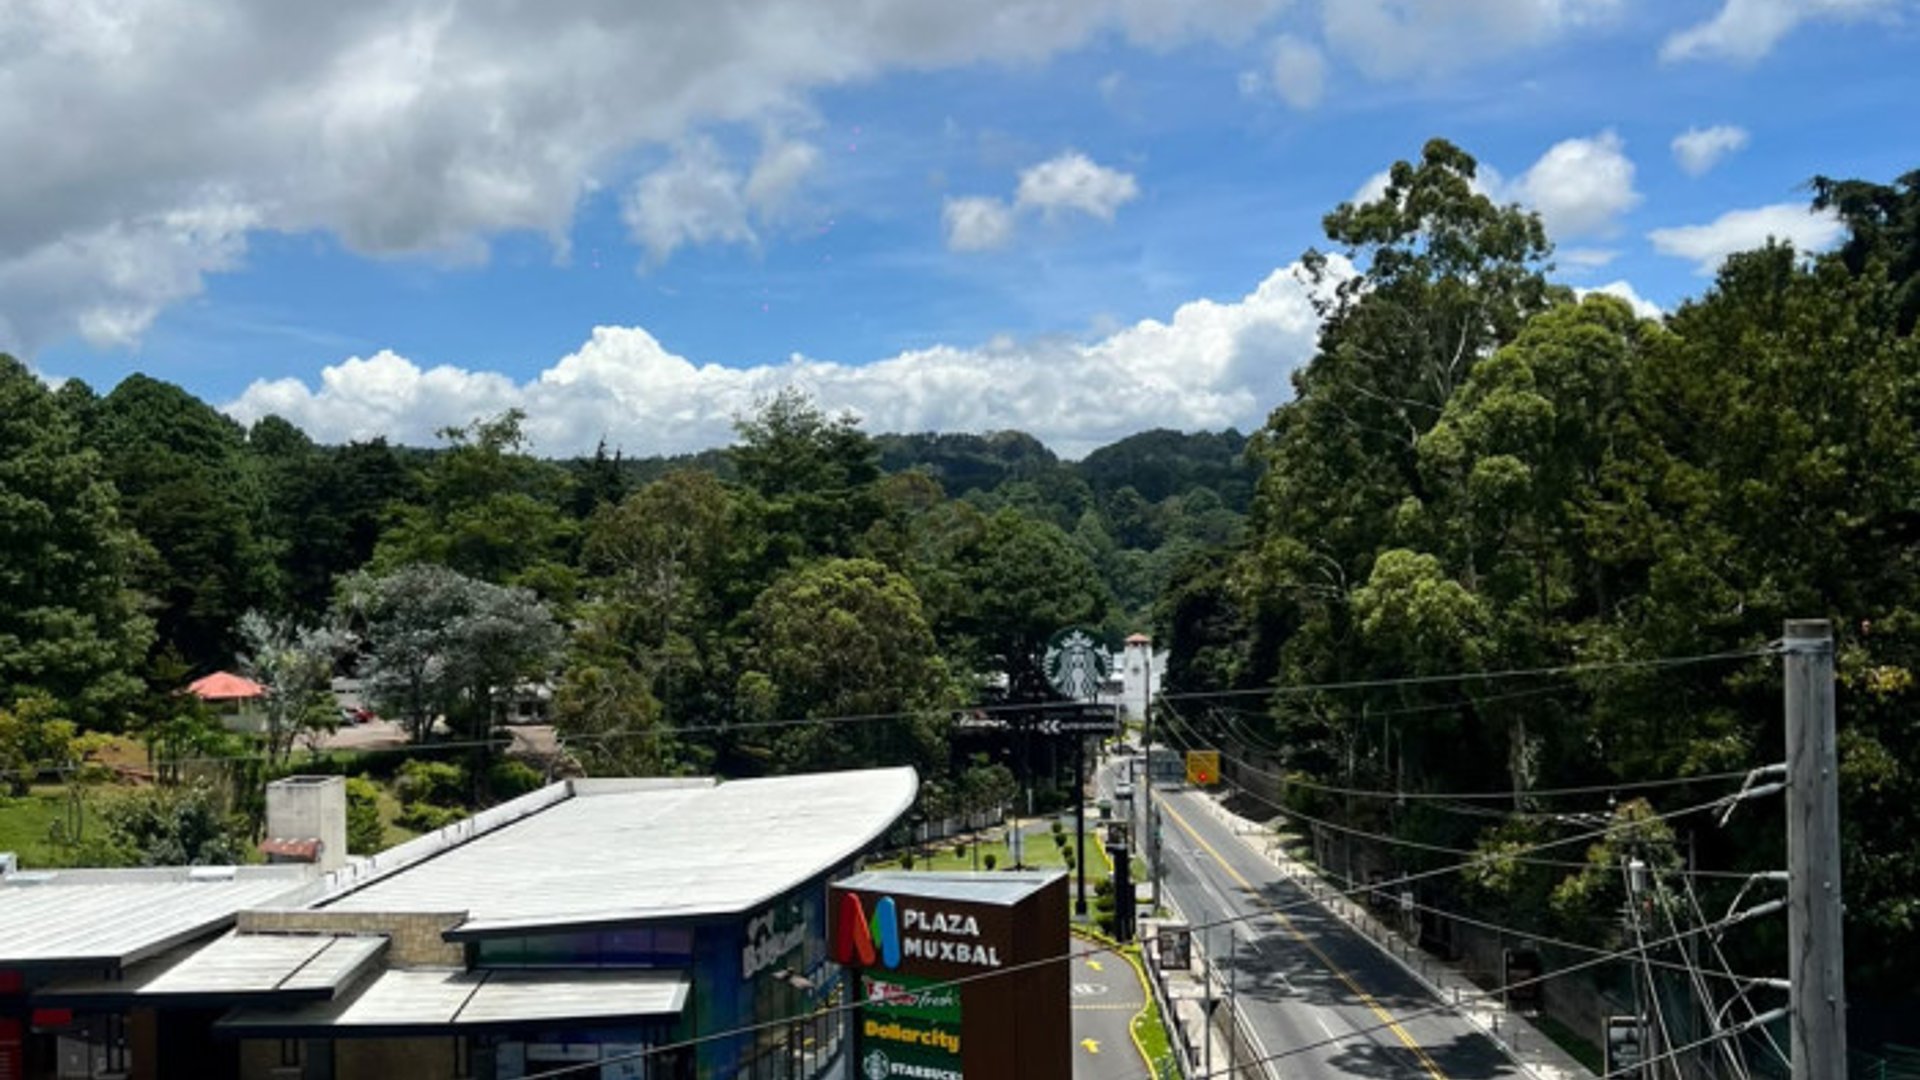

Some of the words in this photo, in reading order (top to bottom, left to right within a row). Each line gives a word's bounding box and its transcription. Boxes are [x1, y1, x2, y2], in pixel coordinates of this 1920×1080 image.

[904, 909, 980, 936] PLAZA
[904, 937, 1002, 967] MUXBAL
[864, 1020, 961, 1054] Dollarcity
